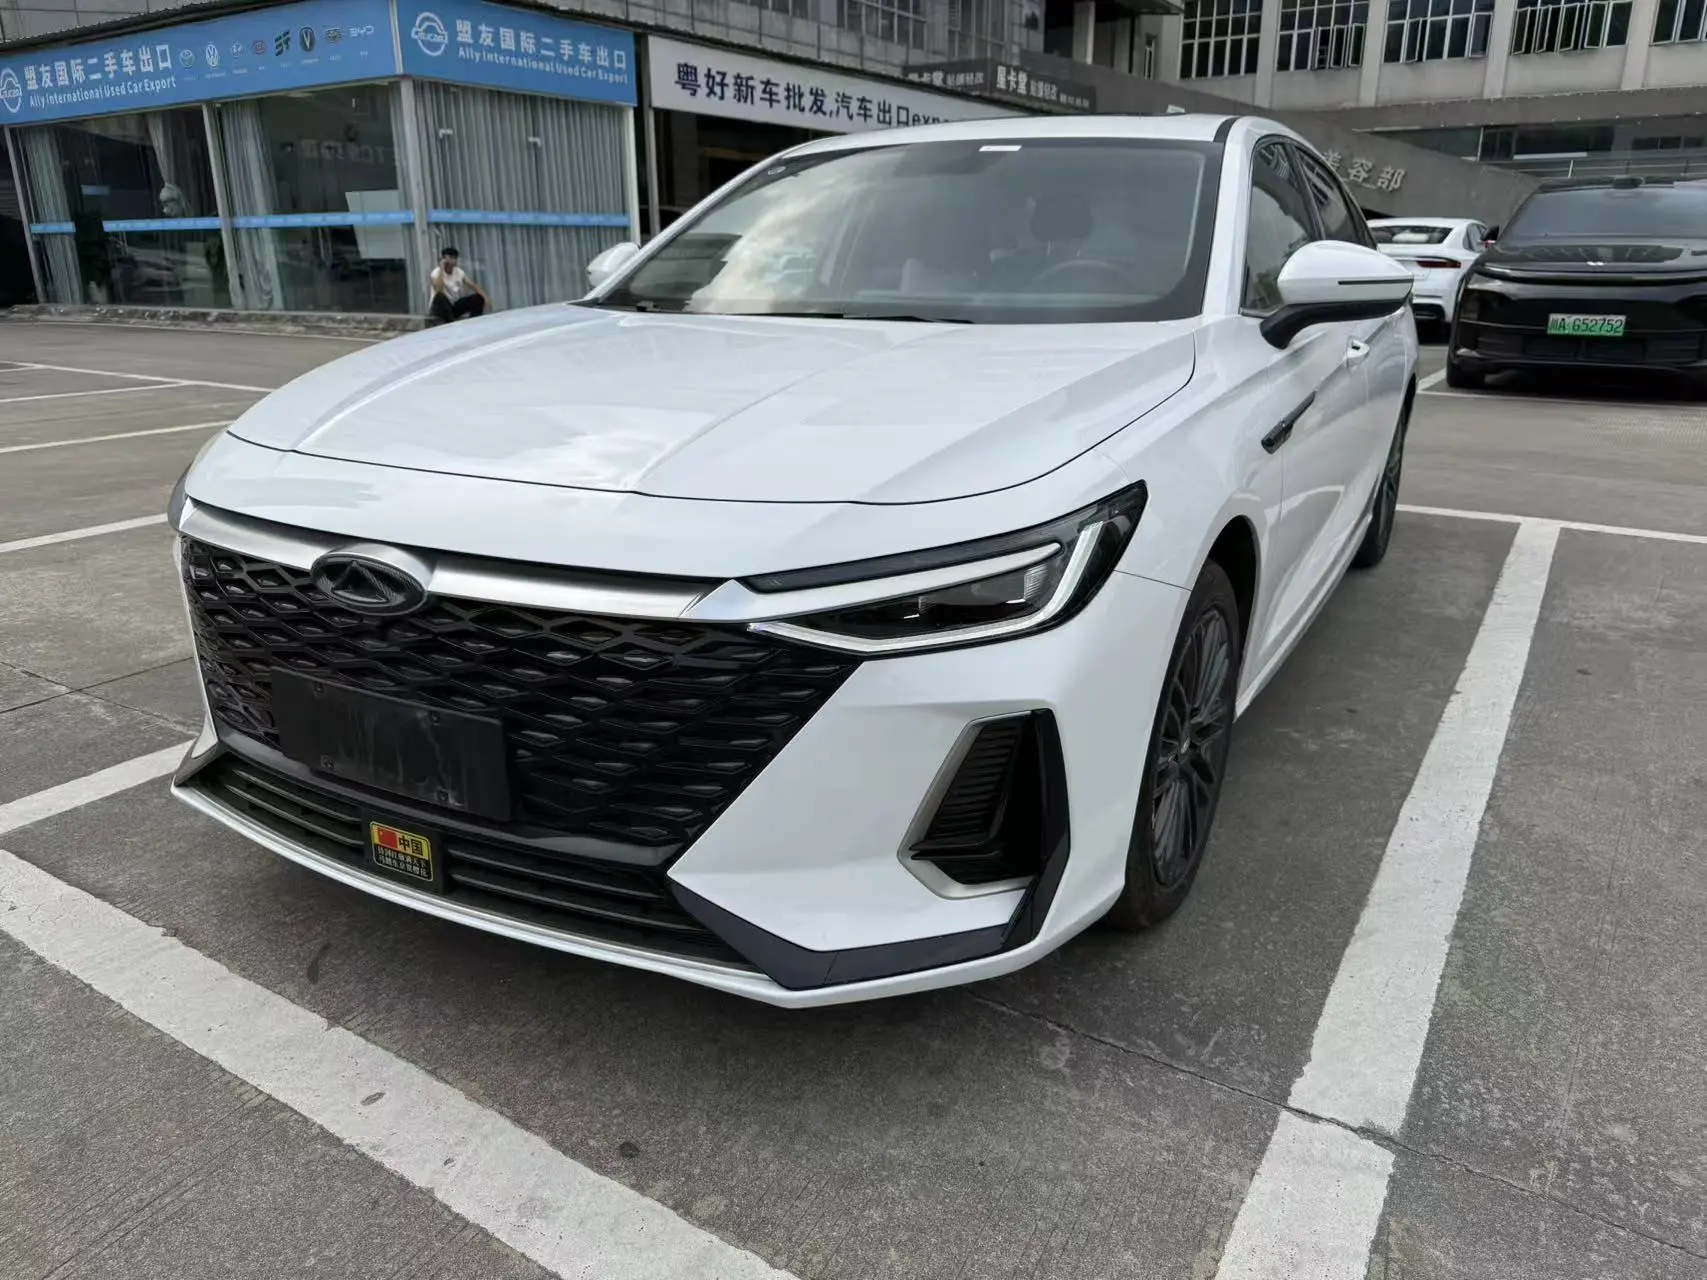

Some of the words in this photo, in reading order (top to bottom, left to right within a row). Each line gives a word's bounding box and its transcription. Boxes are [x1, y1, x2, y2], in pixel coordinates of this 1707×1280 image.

[456, 18, 626, 70] 盟友国际二手车出口
[23, 44, 172, 91] 盟友国际二手车出口
[459, 46, 481, 63] Ally
[556, 62, 579, 76] Used
[581, 66, 597, 78] Car
[598, 69, 628, 84] Export
[29, 93, 45, 109] Ally
[104, 81, 126, 97] Used
[127, 81, 142, 93] Car
[143, 75, 176, 93] Export
[398, 835, 424, 857] 中国
